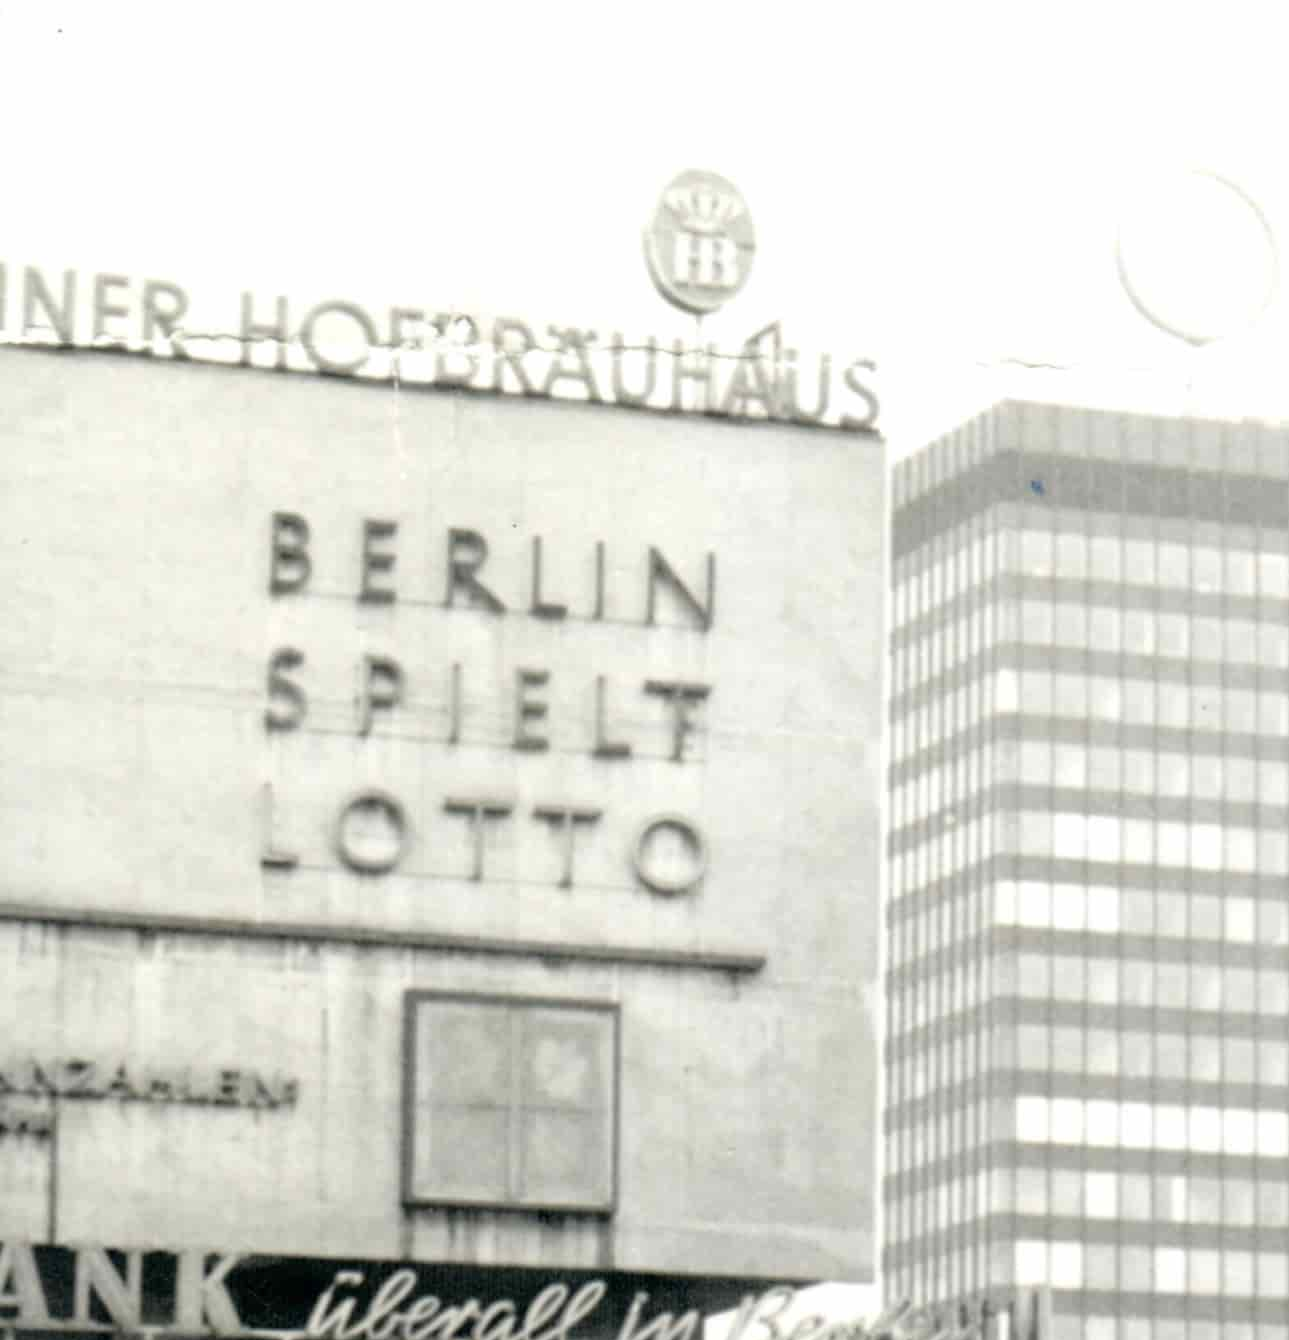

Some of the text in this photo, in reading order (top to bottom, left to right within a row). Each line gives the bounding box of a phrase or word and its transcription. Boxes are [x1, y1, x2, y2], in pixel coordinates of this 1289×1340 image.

[241, 290, 881, 431] HOFBRÄUHAUS
[269, 511, 716, 634] BERLIN
[264, 647, 712, 763] SPIELT
[261, 782, 707, 899] LOTTO
